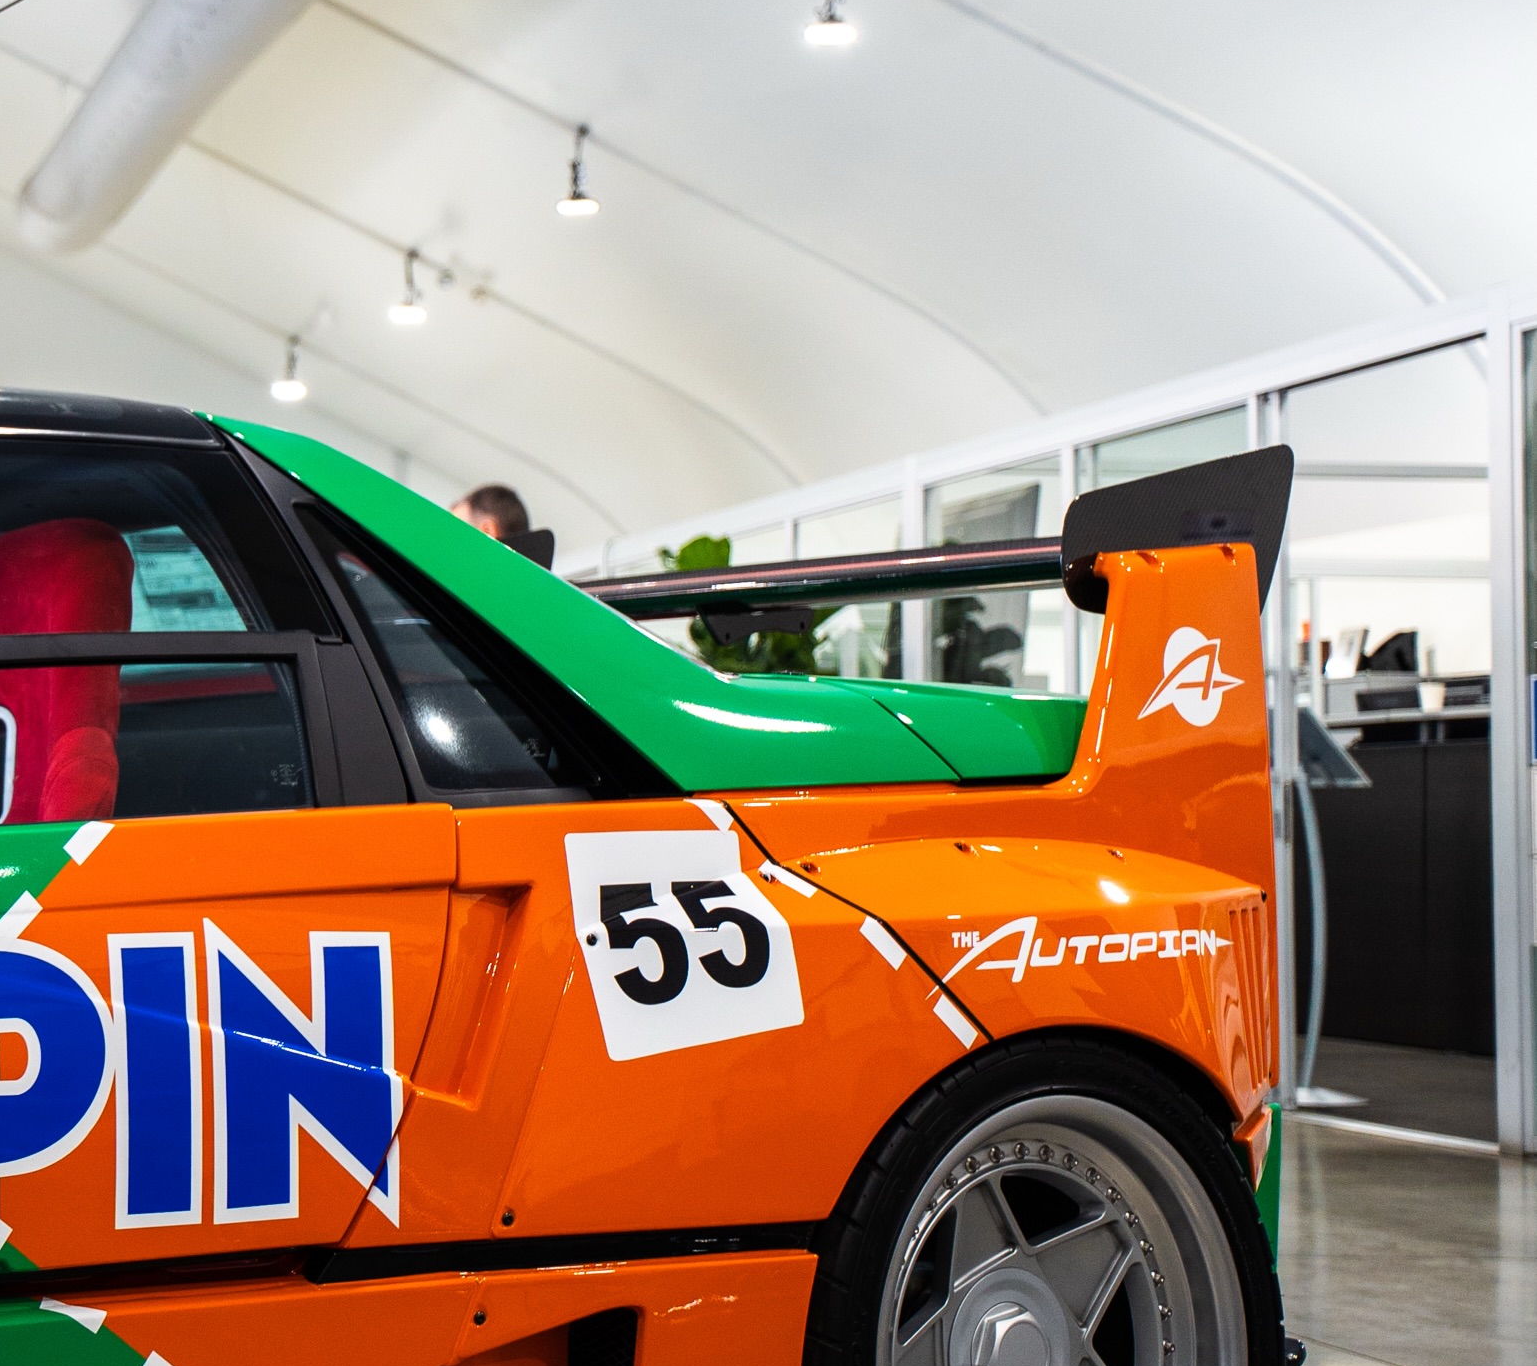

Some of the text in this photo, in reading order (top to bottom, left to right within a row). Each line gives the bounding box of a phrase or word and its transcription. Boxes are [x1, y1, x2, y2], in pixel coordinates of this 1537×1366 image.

[599, 880, 771, 1006] 55
[925, 916, 1219, 1001] THE AUTOPIAN
